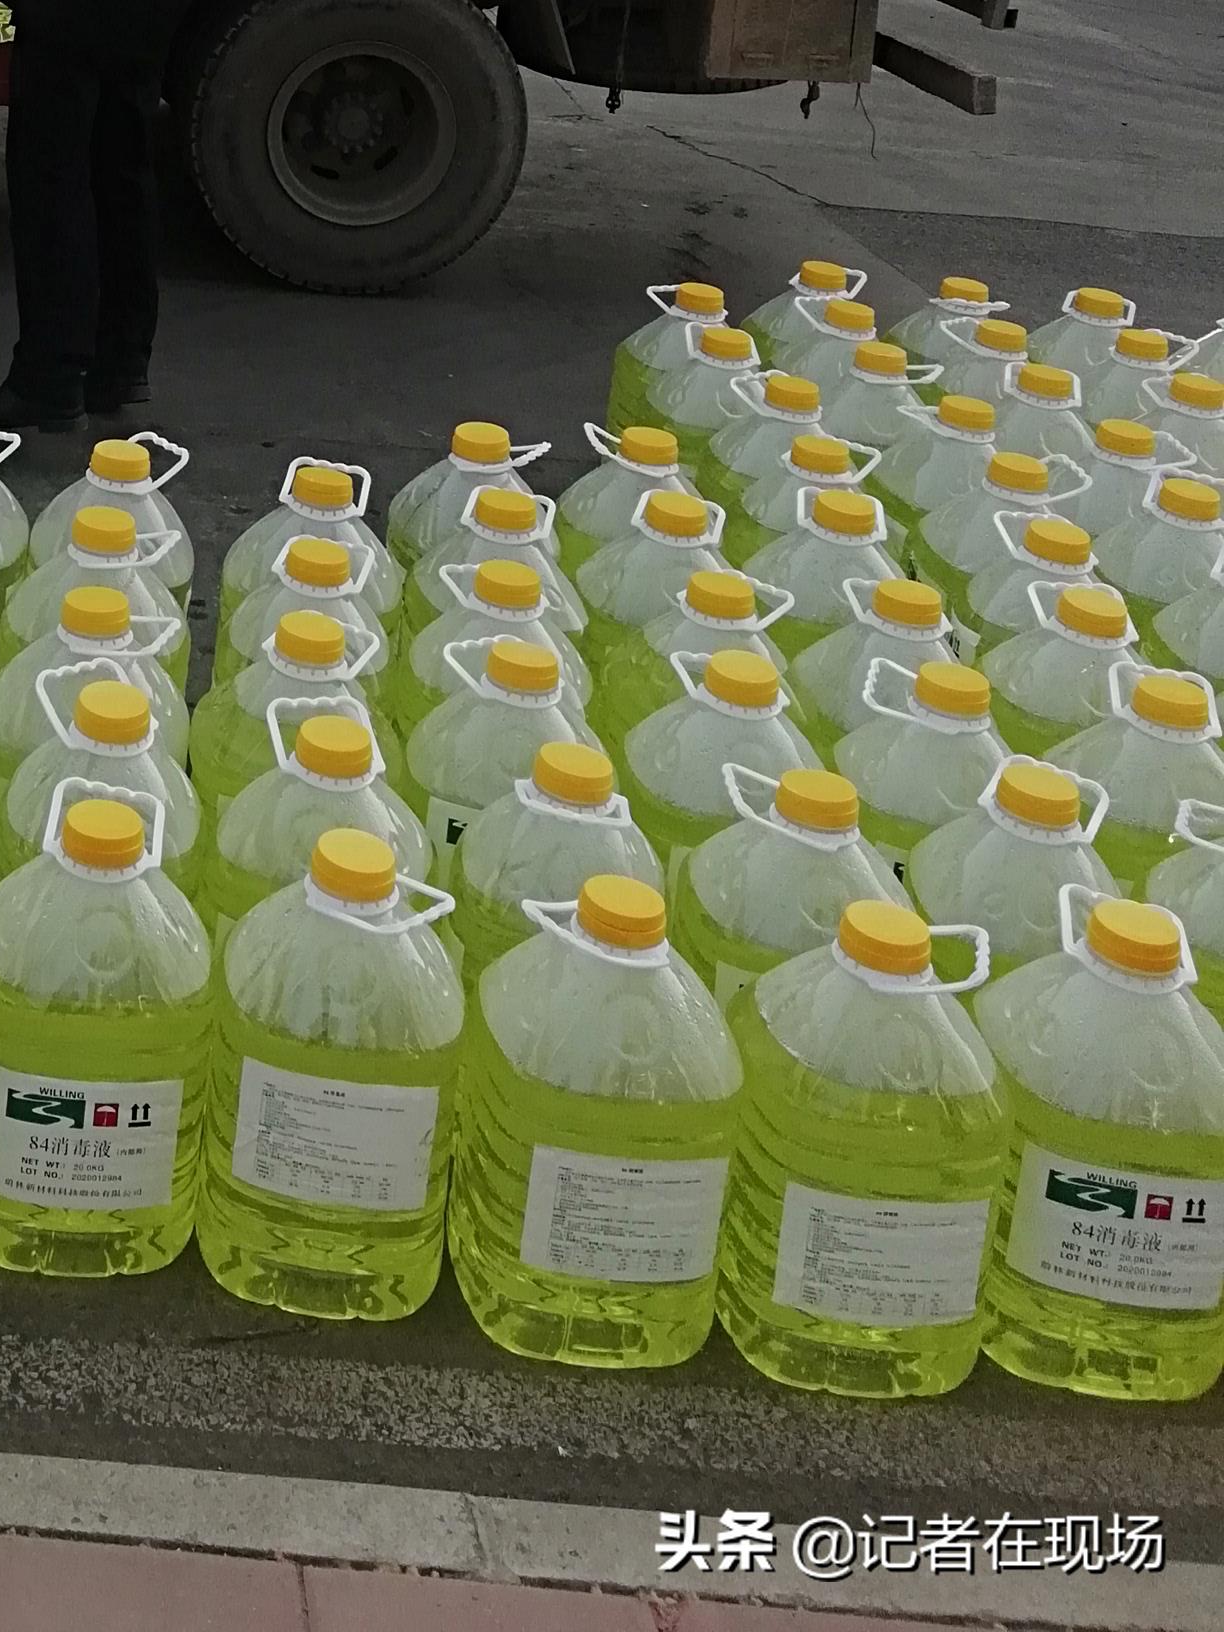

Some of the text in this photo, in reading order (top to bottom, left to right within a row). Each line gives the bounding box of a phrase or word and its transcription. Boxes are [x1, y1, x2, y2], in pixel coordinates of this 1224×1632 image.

[39, 1086, 85, 1100] WILLING
[29, 1135, 112, 1159] 84消毒液
[21, 1156, 39, 1167] NET
[20, 1166, 37, 1176] LOT
[1086, 1171, 1138, 1189] WILLING
[1071, 1220, 1163, 1252] 84消毒液
[1061, 1240, 1081, 1253] NET
[1059, 1251, 1080, 1262] LOT
